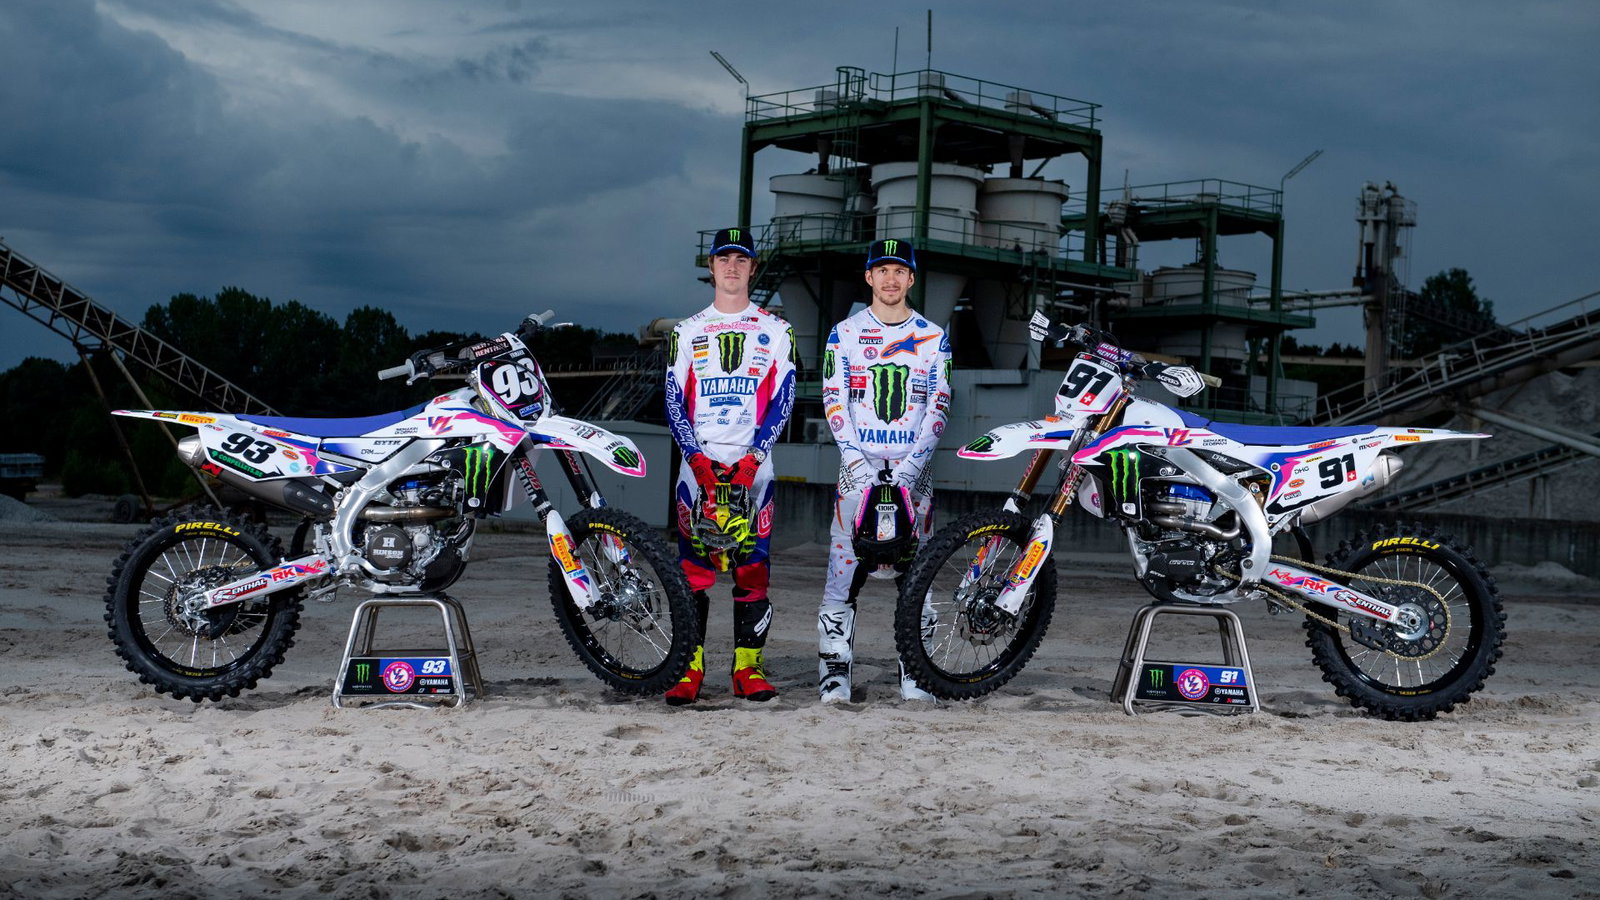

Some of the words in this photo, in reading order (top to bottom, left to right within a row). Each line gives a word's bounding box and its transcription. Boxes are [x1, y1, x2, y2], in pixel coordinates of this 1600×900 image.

[492, 357, 540, 405] 93
[702, 378, 757, 395] YAMAHA
[1058, 362, 1114, 407] 91
[858, 428, 917, 444] YAMAHA
[220, 432, 277, 464] 93
[1317, 452, 1357, 490] 91
[175, 521, 241, 537] PIRELLI
[588, 521, 628, 539] PIRELLI
[967, 524, 1011, 539] PIRELLI
[1372, 537, 1441, 551] PIRELLI
[1021, 544, 1043, 575] PIRELLI
[272, 567, 297, 582] RK
[1303, 577, 1326, 593] RK
[421, 660, 447, 674] 93
[1220, 670, 1239, 683] 91
[1221, 689, 1244, 697] YAMAHA
